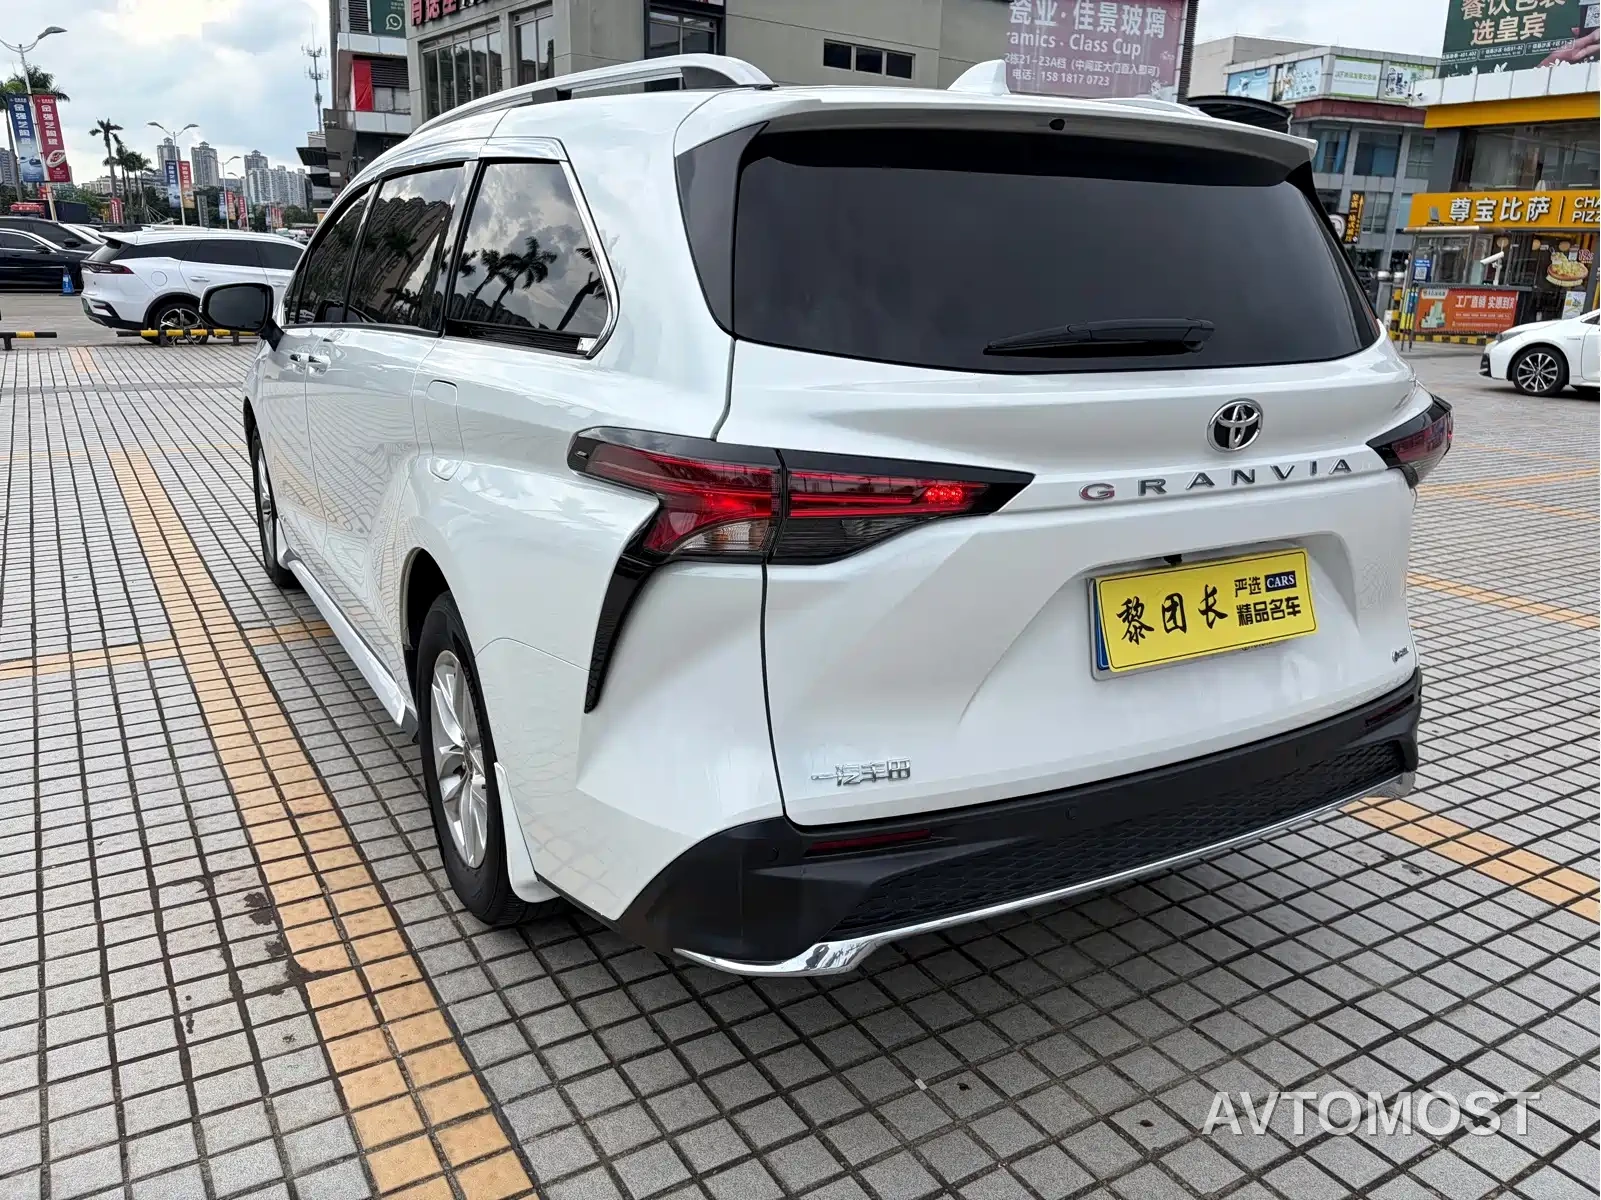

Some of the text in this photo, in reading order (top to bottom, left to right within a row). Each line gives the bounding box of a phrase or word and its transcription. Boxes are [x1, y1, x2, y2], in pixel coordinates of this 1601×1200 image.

[1006, 27, 1141, 60] amics Class Cup
[1470, 12, 1547, 46] 选皇宾
[1041, 71, 1058, 82] 158
[1061, 73, 1084, 84] 1817
[1086, 75, 1110, 86] 0723
[1450, 196, 1551, 222] 尊宝比萨
[1079, 458, 1352, 500] GRANVIA
[1234, 573, 1296, 598] 严选 CARS
[1236, 596, 1302, 627] 精品名车
